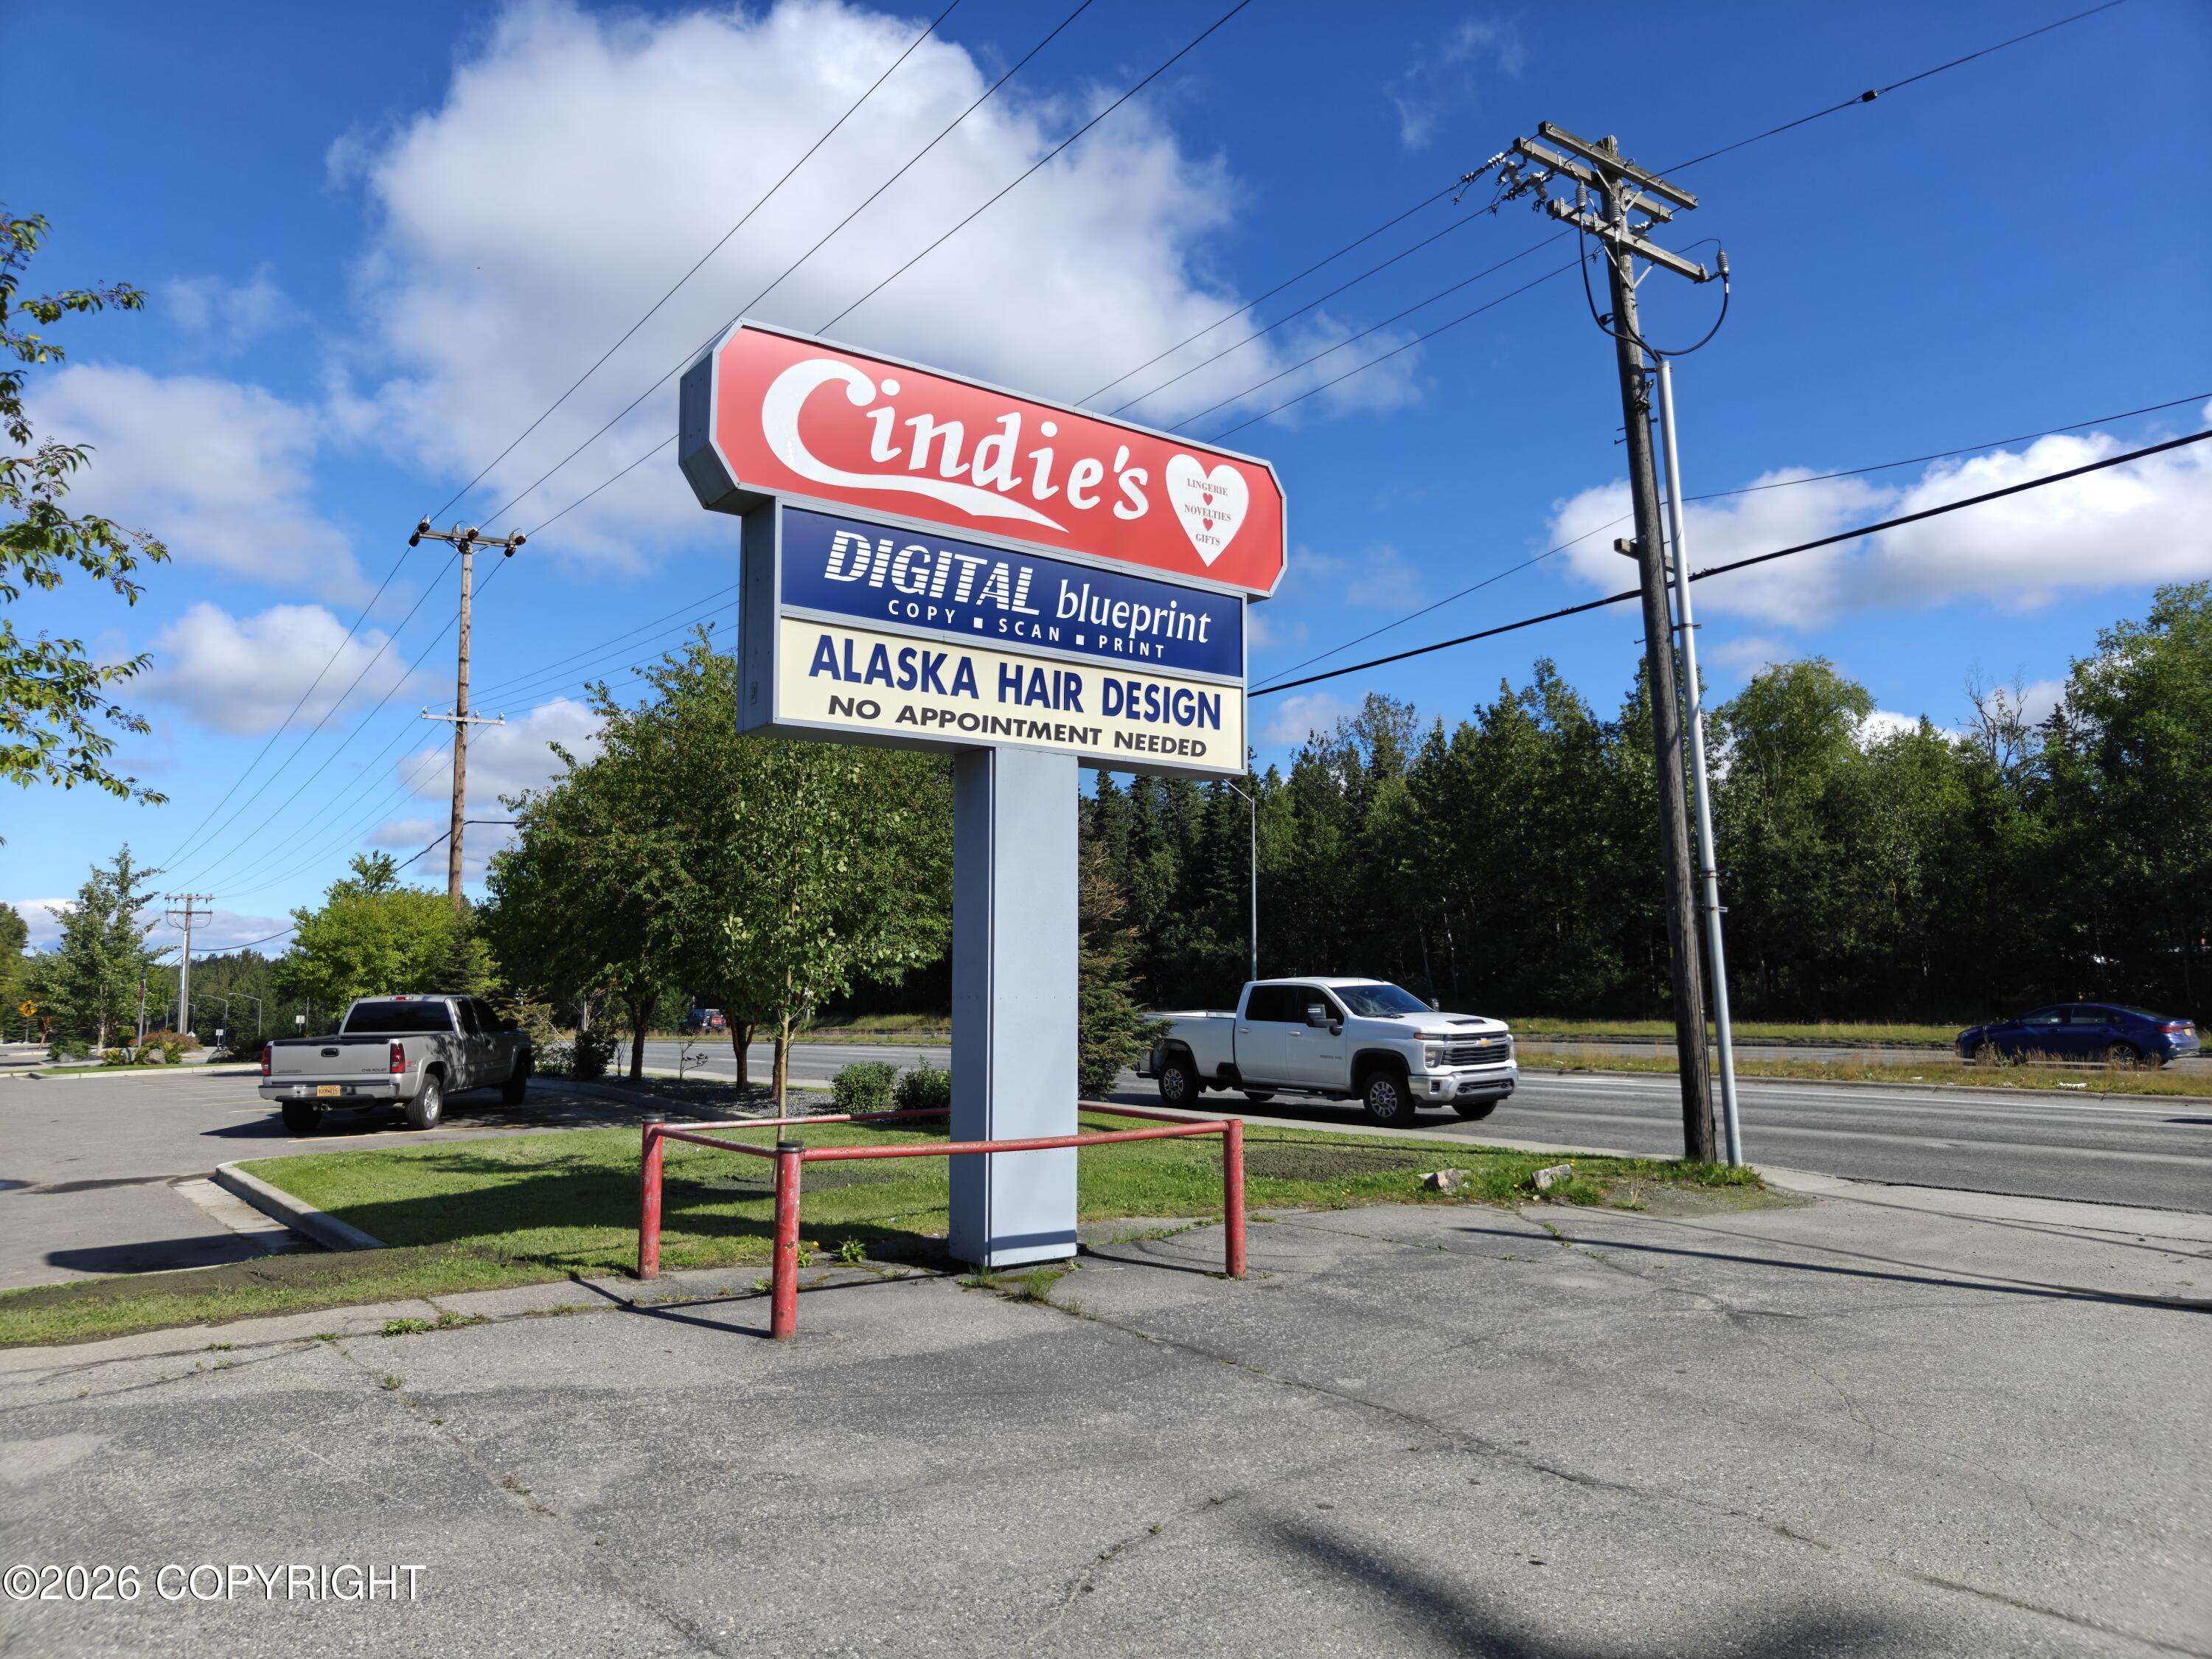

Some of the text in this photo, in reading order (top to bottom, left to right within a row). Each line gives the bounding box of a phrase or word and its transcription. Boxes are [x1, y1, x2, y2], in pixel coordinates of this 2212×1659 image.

[762, 358, 1149, 533] Cindie's
[1184, 504, 1231, 522] NOVELTIES
[1186, 478, 1228, 496] LINGERIE
[1195, 533, 1220, 546] GIFTS
[824, 530, 1211, 643] DIGITAL blueprint
[888, 599, 1164, 658] COPY SCAN PRINT
[809, 634, 1221, 730] ALASKA HAIR DESIGN
[828, 695, 1206, 757] NO APPOINTMENT NEEDED
